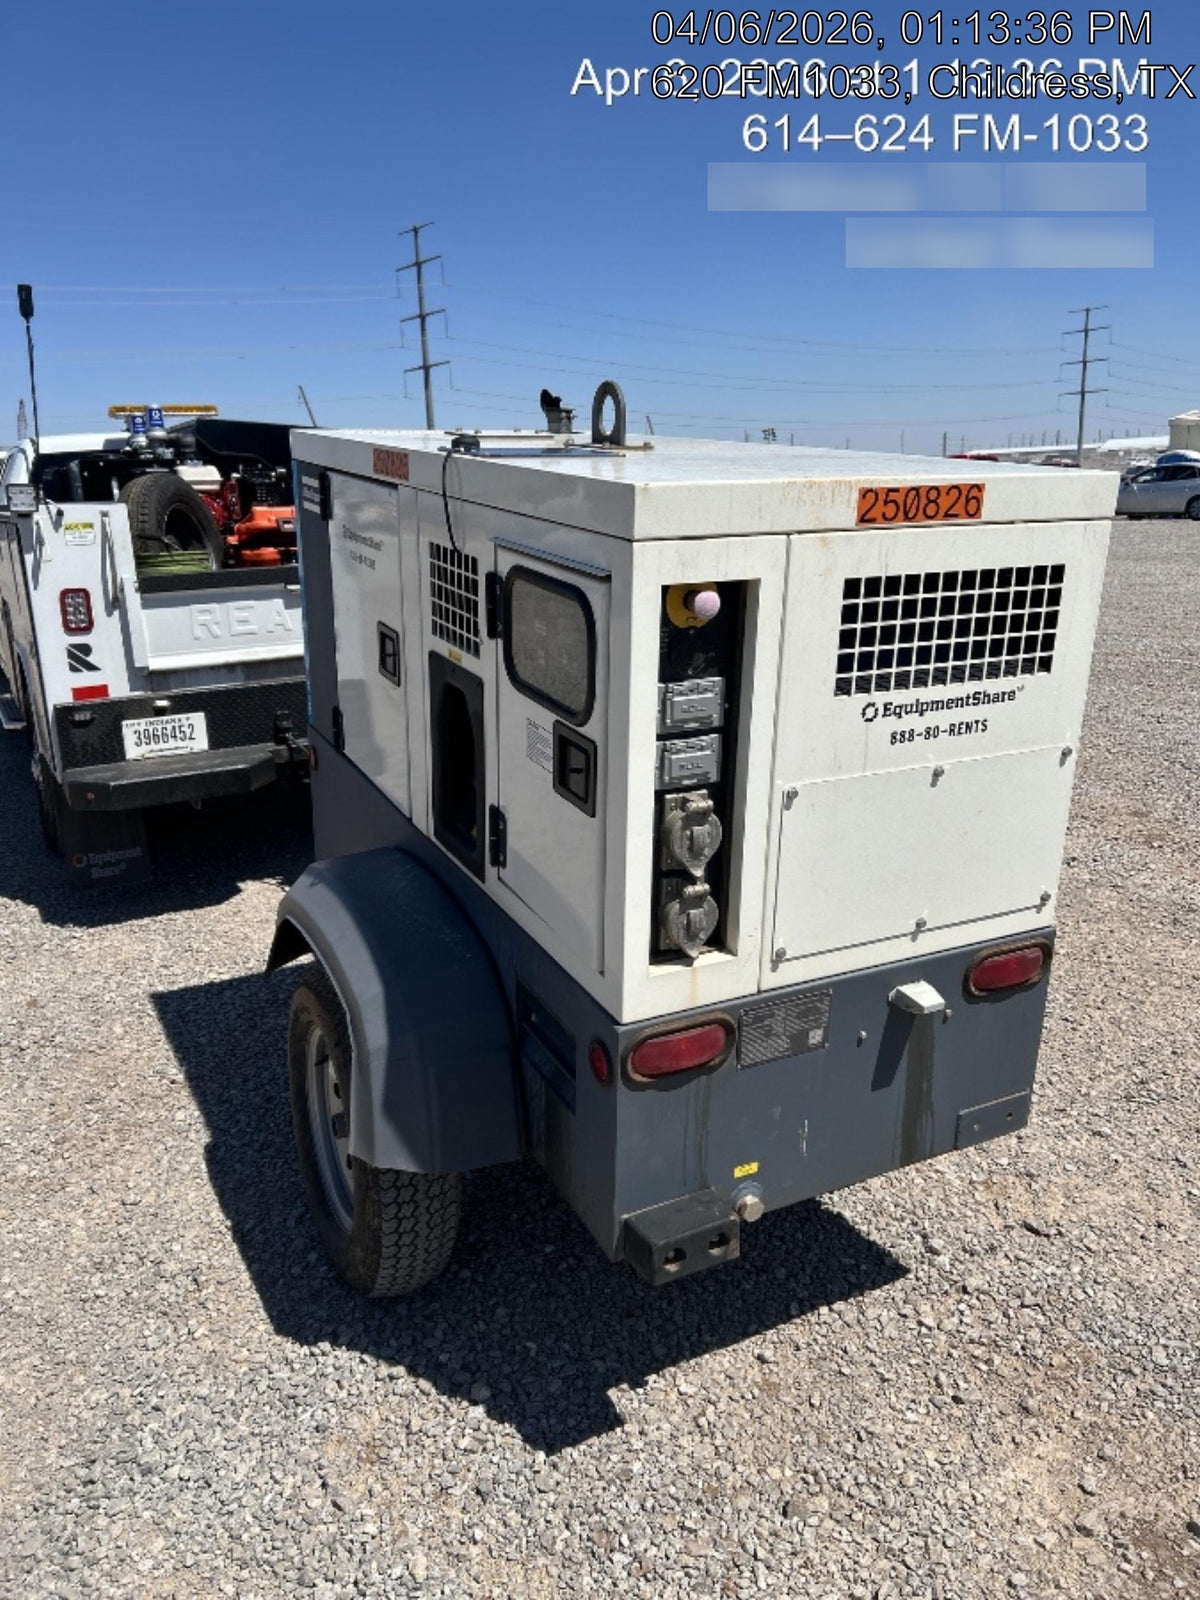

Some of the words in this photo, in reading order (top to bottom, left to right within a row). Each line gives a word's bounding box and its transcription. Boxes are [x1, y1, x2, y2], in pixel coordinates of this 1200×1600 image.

[858, 484, 983, 523] 250826
[881, 689, 1017, 719] EquipmentShare
[133, 723, 196, 747] 3966452
[889, 718, 989, 746] 888-80-RENTS
